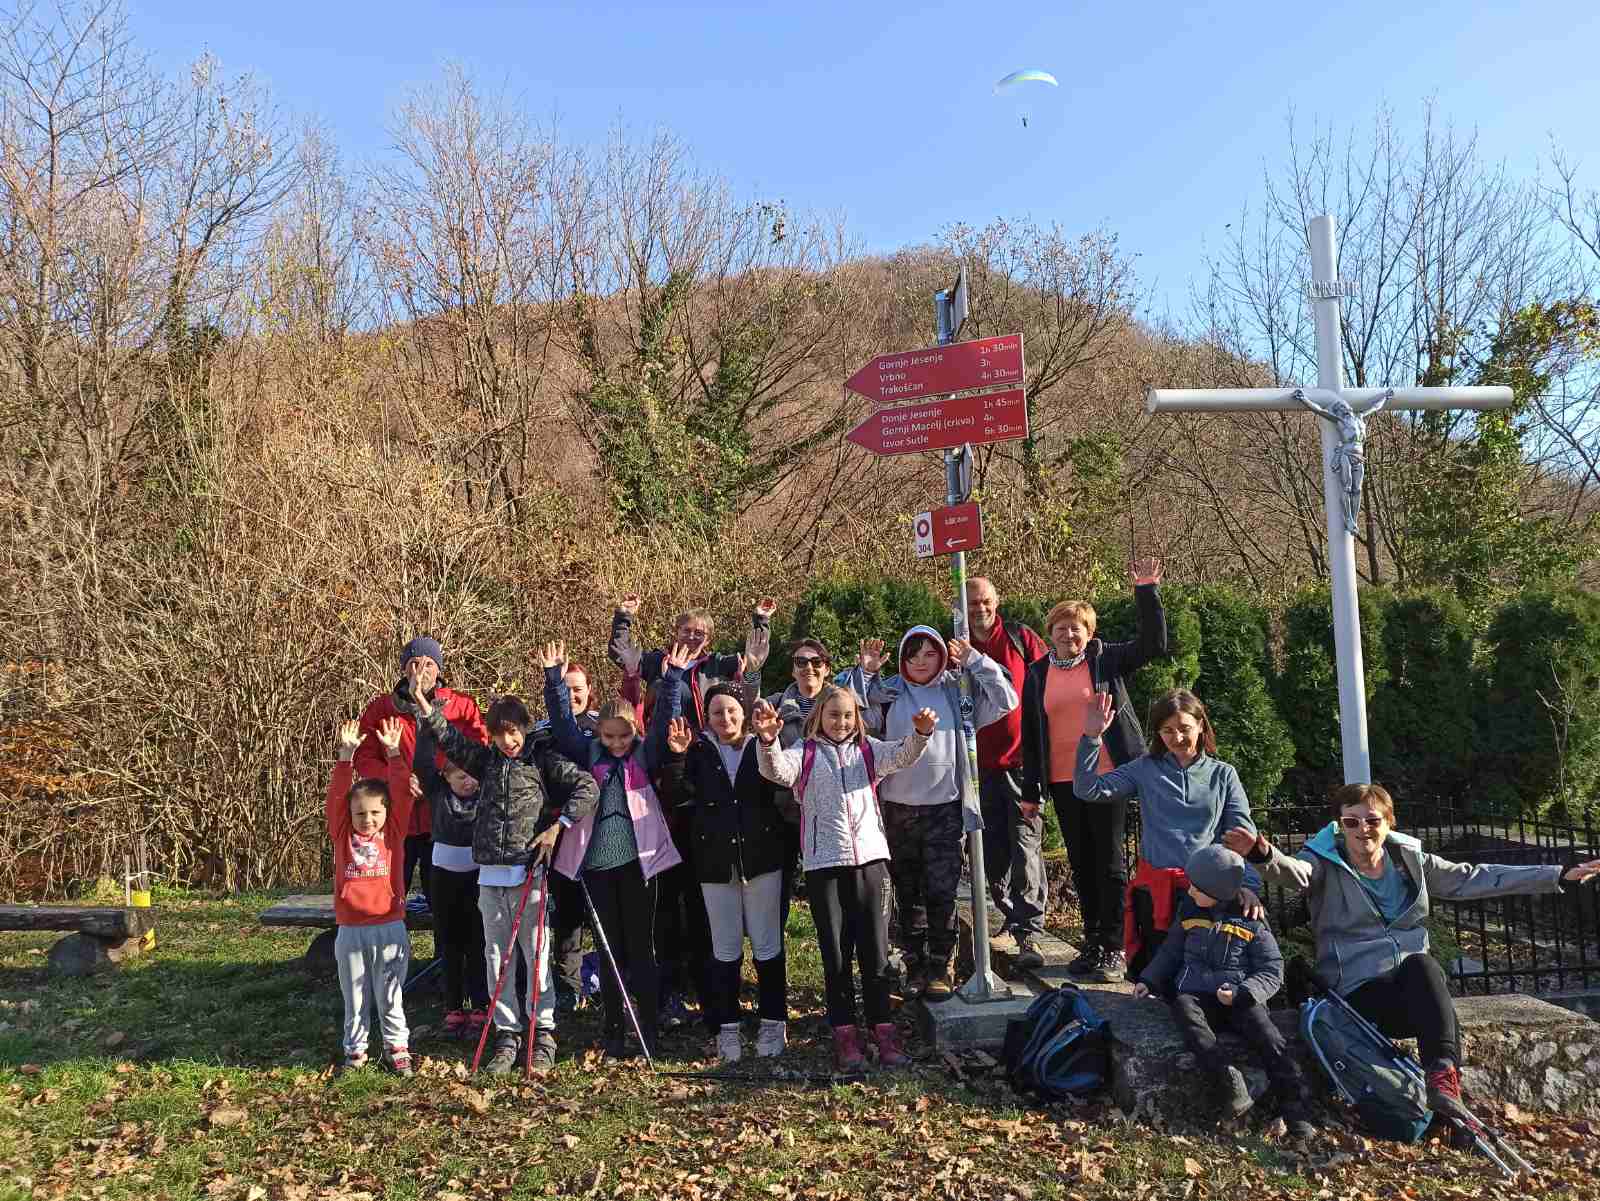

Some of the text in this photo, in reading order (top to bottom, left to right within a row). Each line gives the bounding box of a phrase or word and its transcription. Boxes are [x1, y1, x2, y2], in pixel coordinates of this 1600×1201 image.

[879, 343, 1018, 370] Gornje Jesenje 1h 30min
[880, 358, 991, 382] Vrbno 3h
[981, 371, 991, 380] 4h
[993, 368, 1019, 378] 30min
[881, 397, 1020, 425] Donje Jesenje 1h 45min
[882, 425, 909, 437] Gornji
[911, 420, 941, 432] Macelj
[944, 416, 975, 429] (crkva)
[883, 438, 904, 448] Izvor
[906, 435, 929, 446] Sutle
[998, 423, 1023, 434] 30min
[918, 543, 932, 554] 304
